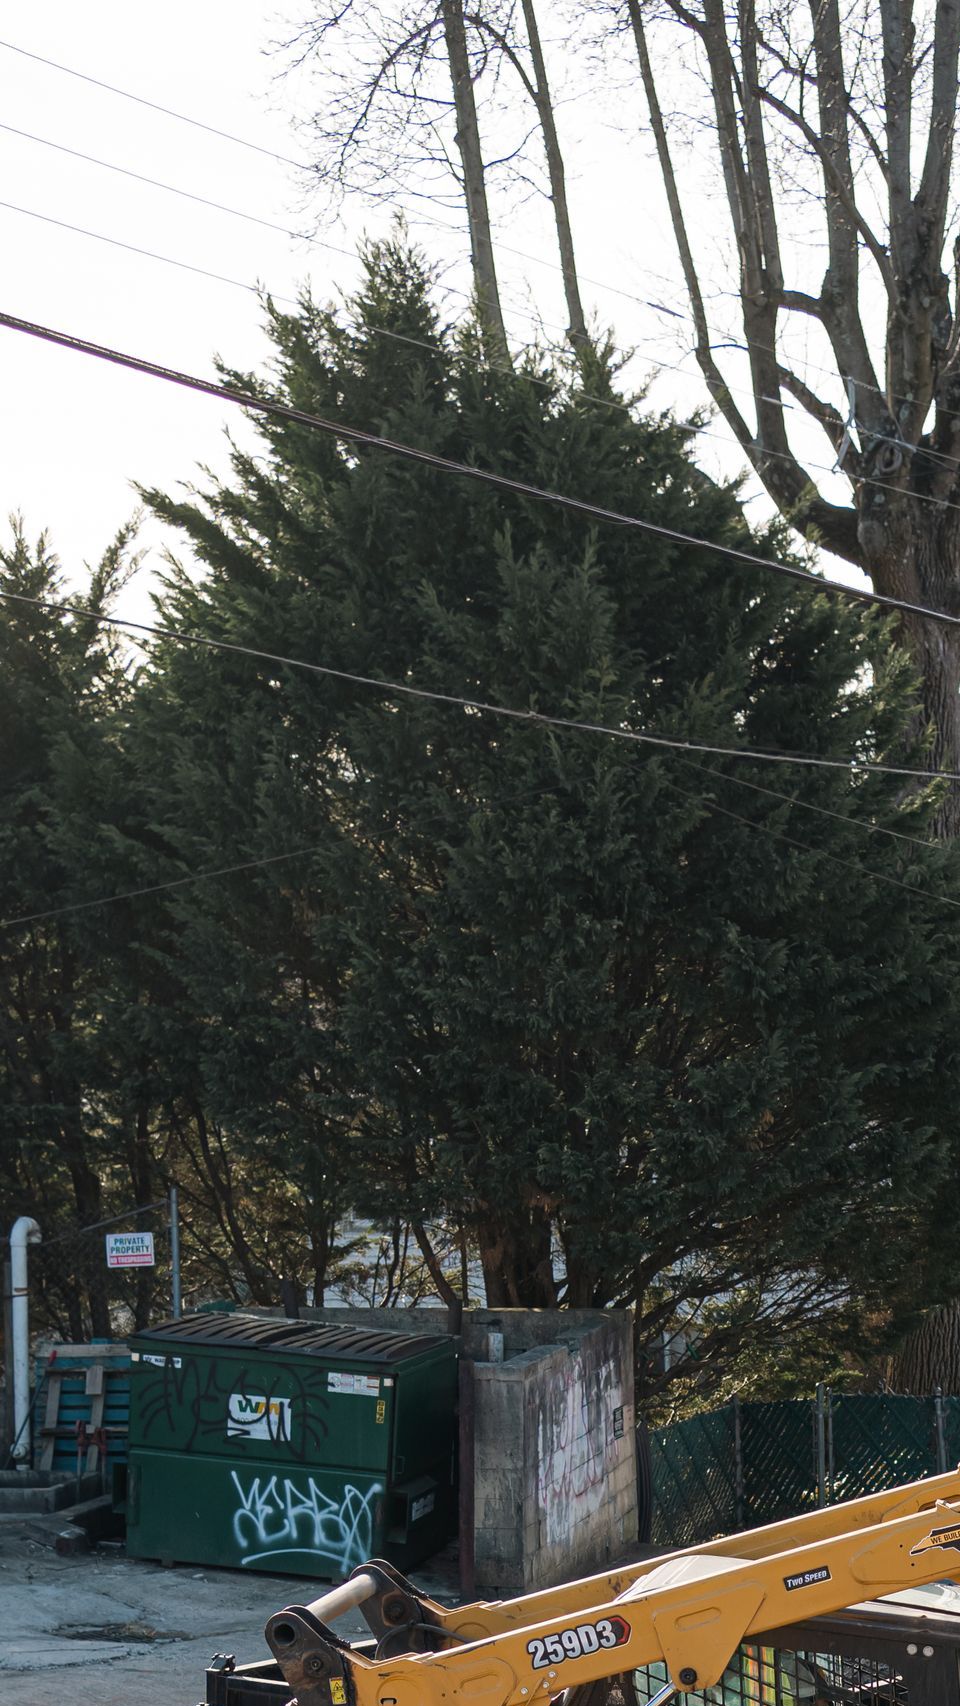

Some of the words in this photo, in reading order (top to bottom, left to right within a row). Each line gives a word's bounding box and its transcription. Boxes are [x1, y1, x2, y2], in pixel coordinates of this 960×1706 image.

[114, 1236, 145, 1246] PRIVATE
[111, 1245, 149, 1254] PROPERTY
[930, 1535, 942, 1544] WE
[527, 1619, 617, 1669] 259D3
